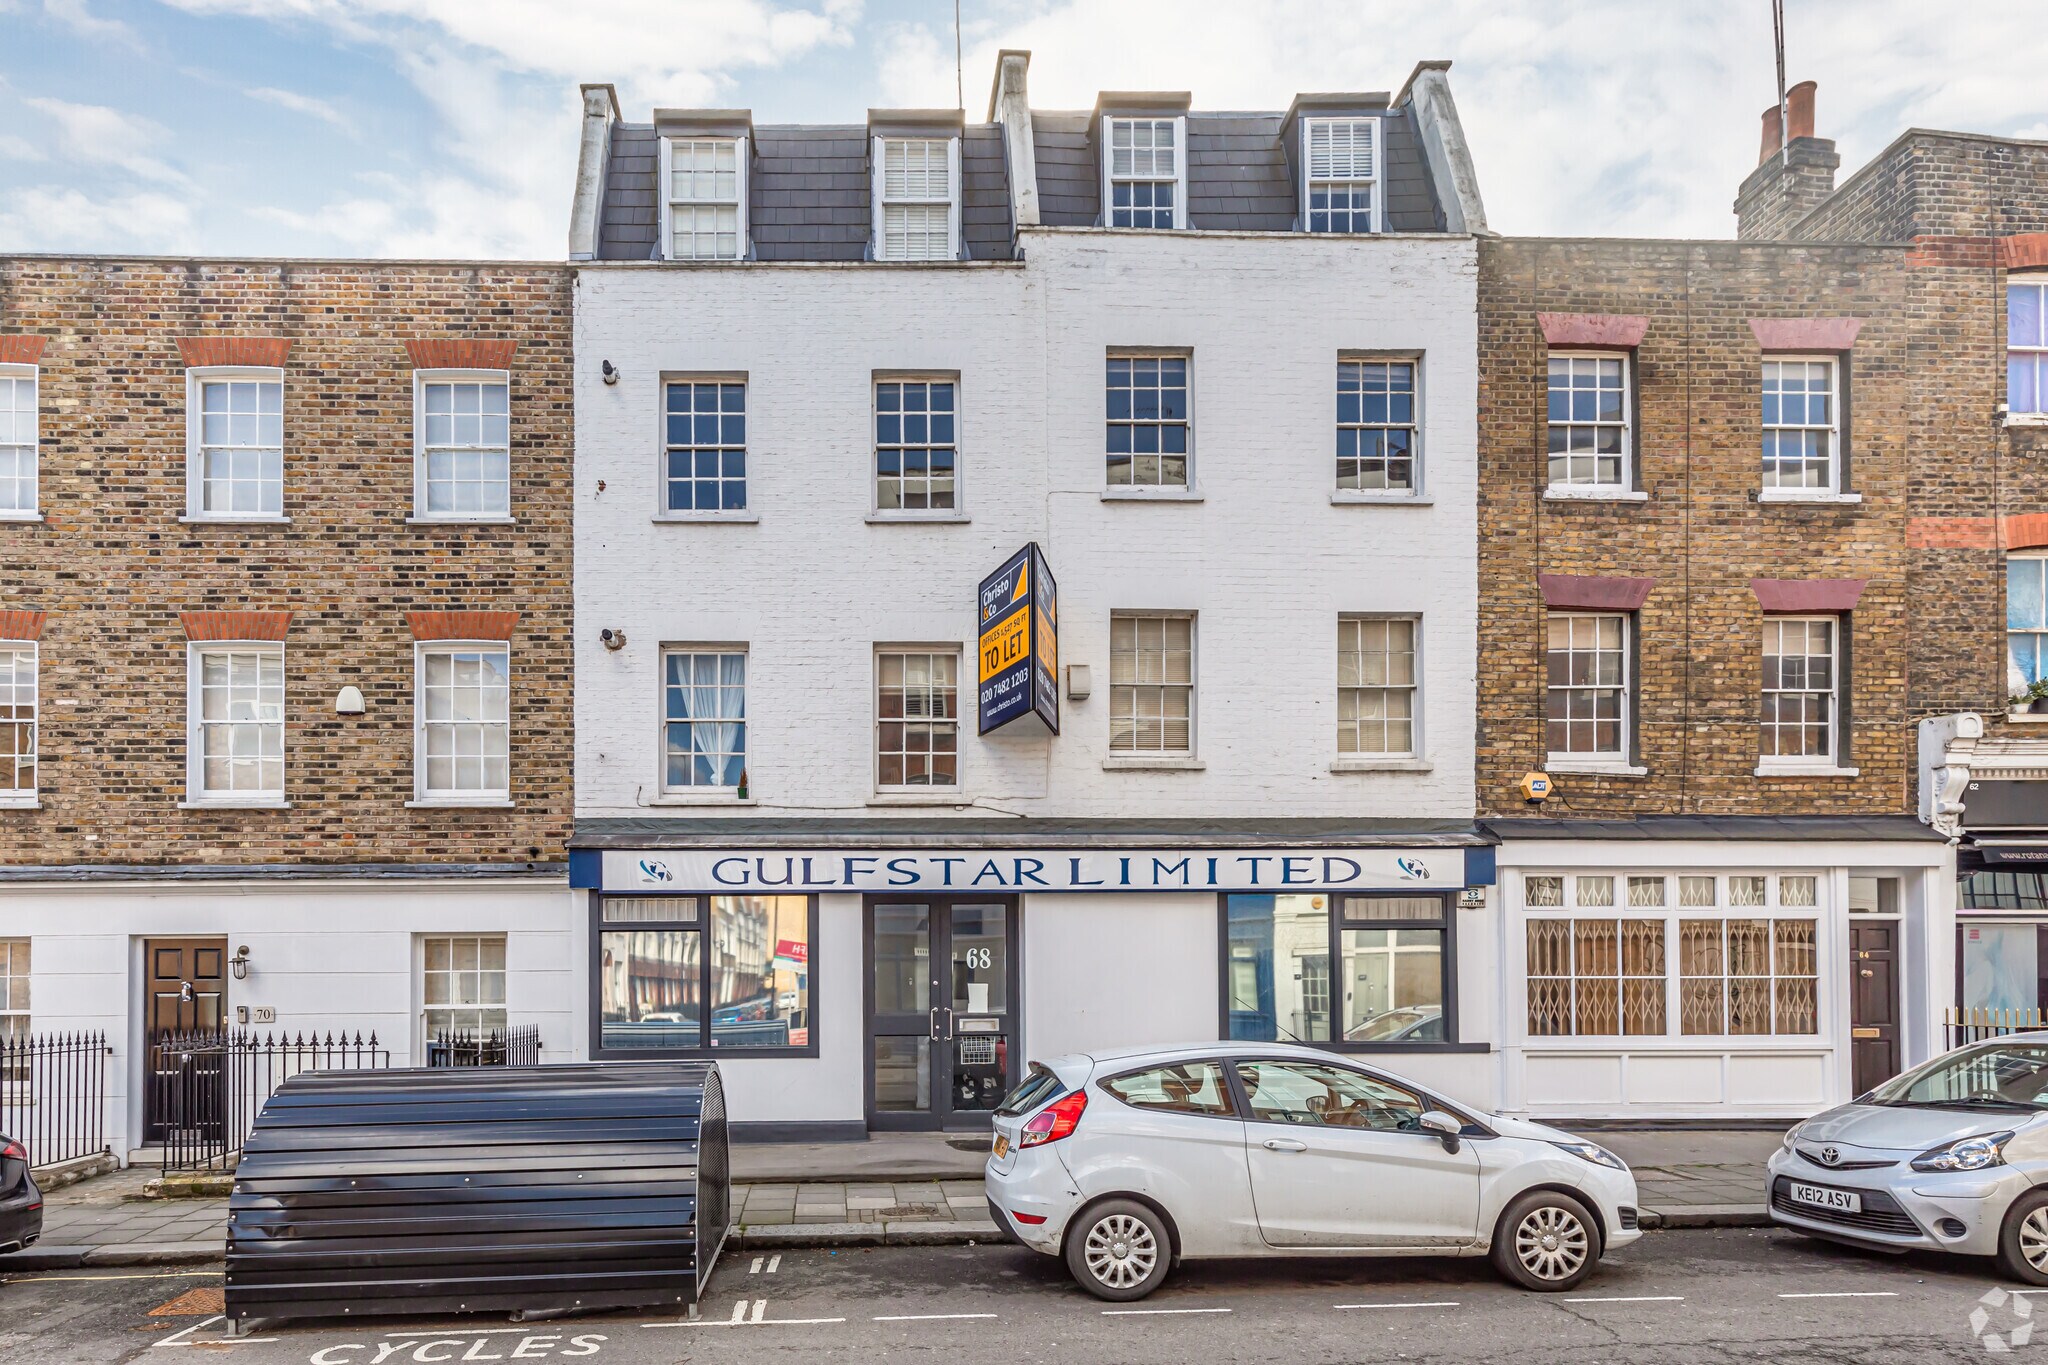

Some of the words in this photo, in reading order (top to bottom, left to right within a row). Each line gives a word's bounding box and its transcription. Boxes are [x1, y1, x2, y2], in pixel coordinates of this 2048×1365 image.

[983, 579, 1009, 607] Christo
[982, 629, 1000, 648] OFFICES
[1013, 617, 1021, 628] SQ
[1021, 612, 1027, 623] FT
[984, 646, 999, 673] TO
[1004, 629, 1023, 663] LET
[981, 688, 993, 704] 020
[993, 677, 1010, 698] 7482
[1011, 667, 1029, 688] 1203
[986, 692, 1022, 717] www.christo.co.uk
[711, 857, 1051, 887] GULFSTAR
[1068, 857, 1362, 886] LIMITED
[966, 948, 992, 969] 68
[256, 1009, 271, 1020] 70
[1797, 1186, 1823, 1203] KE12
[1827, 1191, 1851, 1208] ASV
[309, 1334, 609, 1365] CYCLES
